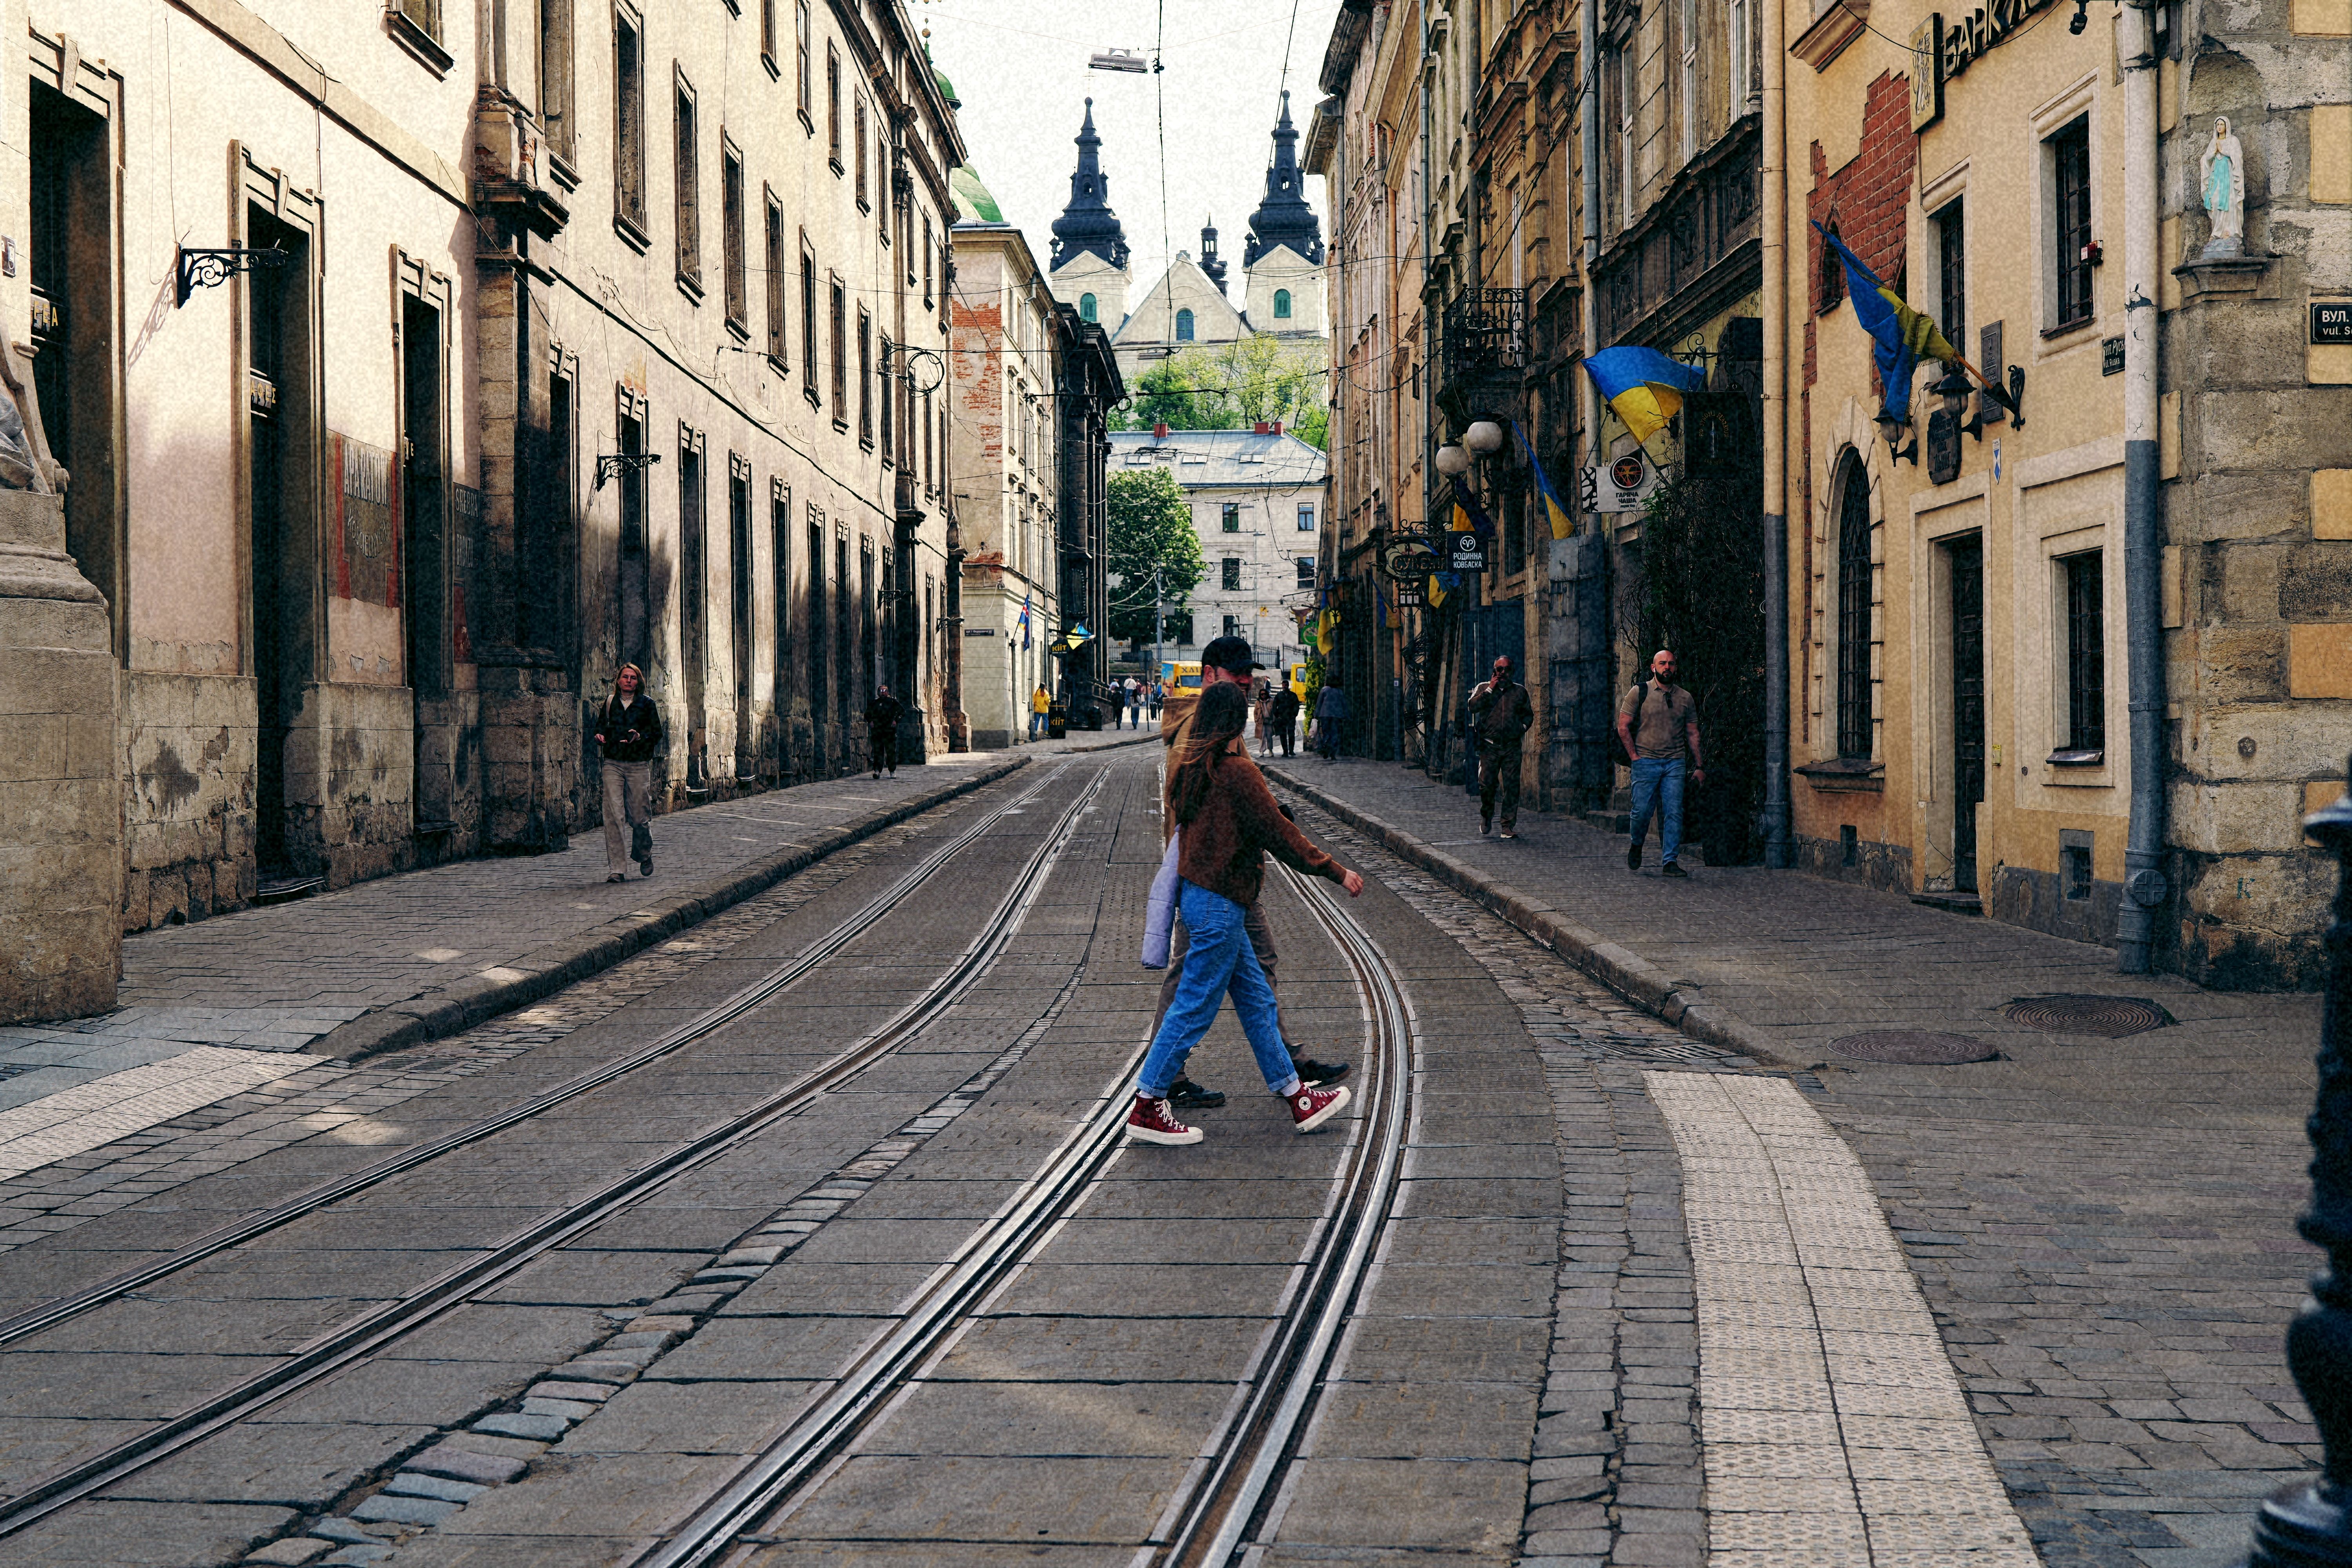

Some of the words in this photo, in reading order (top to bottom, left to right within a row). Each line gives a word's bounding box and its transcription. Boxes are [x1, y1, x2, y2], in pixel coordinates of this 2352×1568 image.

[2323, 326, 2341, 335] vul.
[2344, 326, 2352, 335] S
[2109, 357, 2120, 367] Ruska
[456, 488, 478, 517] SREBRA
[457, 534, 473, 568] BRONZU
